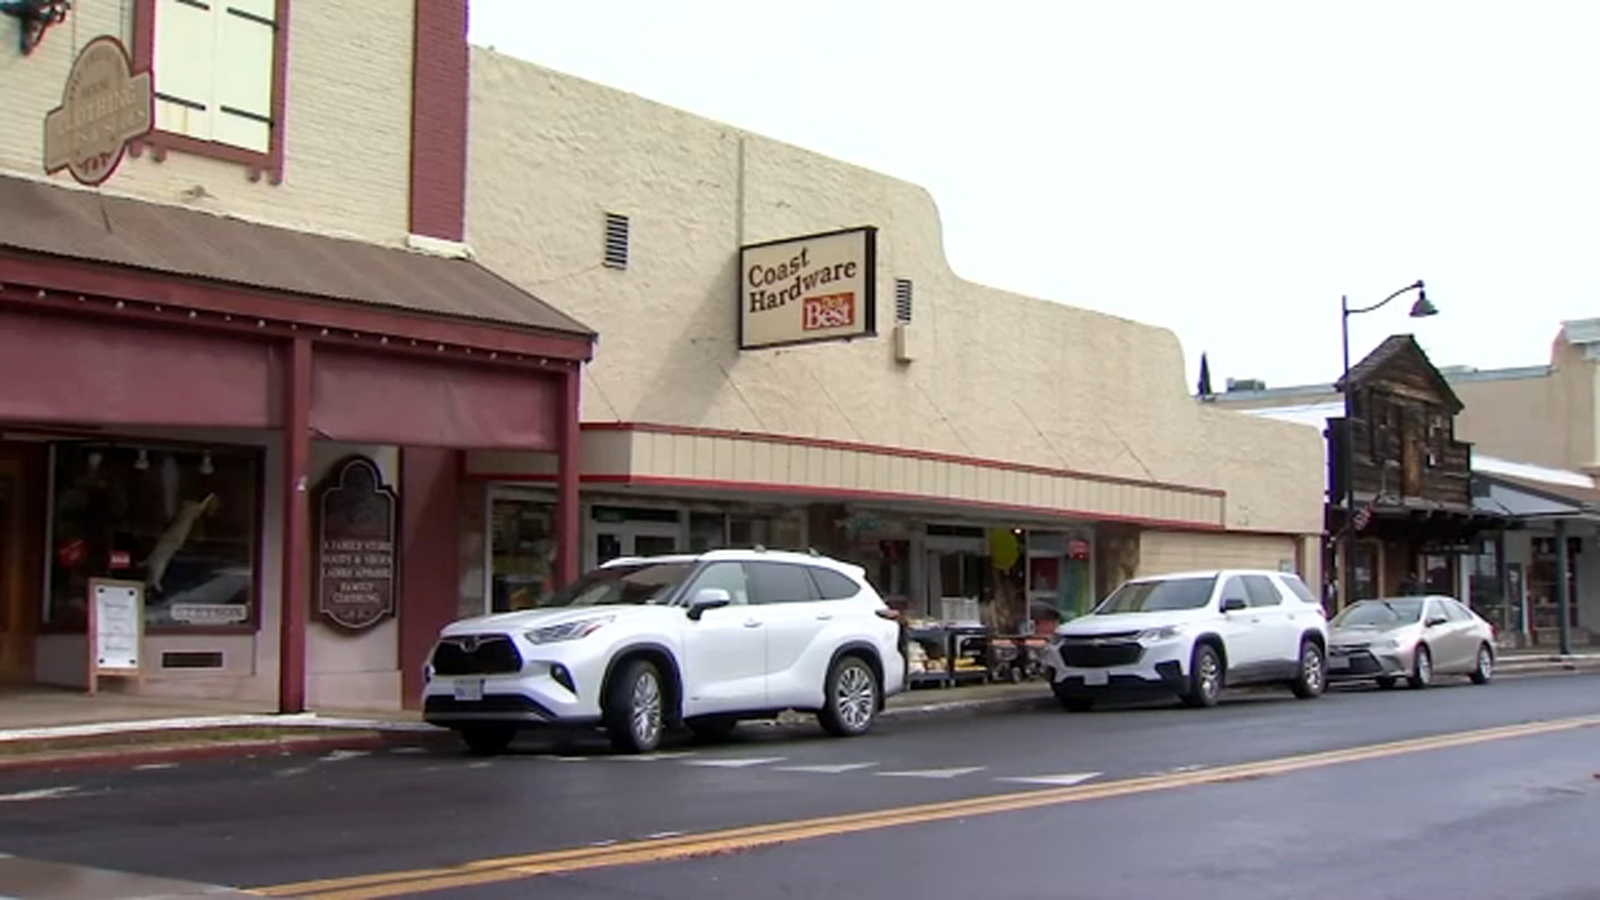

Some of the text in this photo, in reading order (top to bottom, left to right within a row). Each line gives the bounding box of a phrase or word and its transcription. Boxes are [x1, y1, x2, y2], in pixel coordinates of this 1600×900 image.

[748, 247, 810, 288] Coast
[749, 261, 856, 313] Hardware
[806, 301, 850, 328] Best
